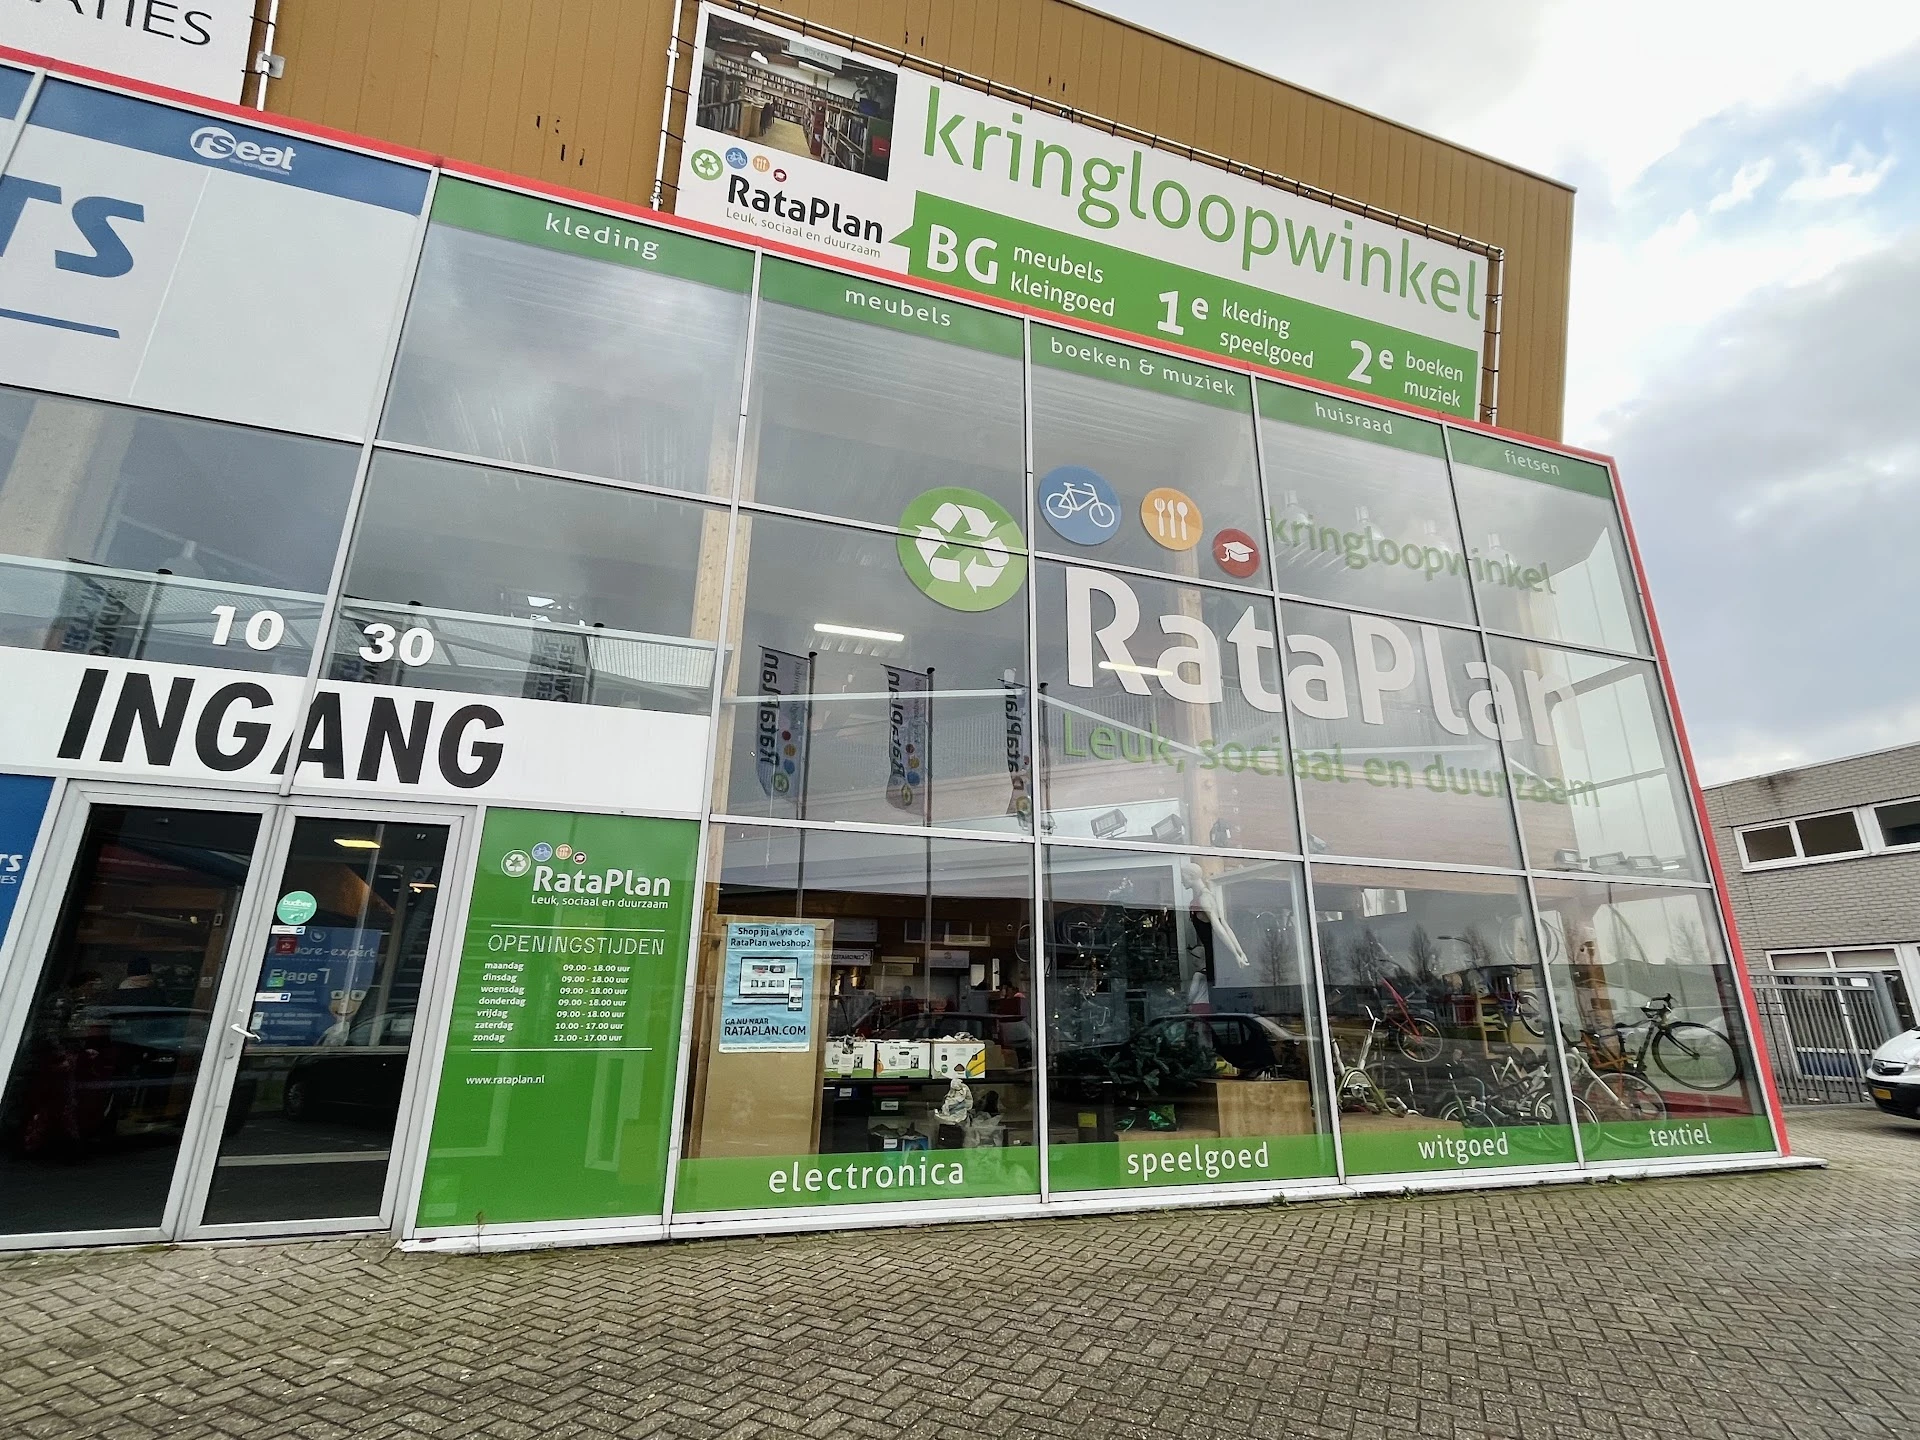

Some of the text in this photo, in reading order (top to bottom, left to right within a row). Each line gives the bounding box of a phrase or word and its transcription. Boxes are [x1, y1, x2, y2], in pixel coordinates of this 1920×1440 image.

[728, 174, 883, 244] RataPlan
[924, 86, 1480, 321] kringloopwinkel
[545, 212, 660, 260] kleding
[726, 208, 881, 258] Leuk, sociaal en duurzaam
[927, 224, 999, 285] BG
[1013, 246, 1104, 283] meubels
[845, 288, 951, 327] meubels
[1010, 271, 1115, 317] kleingoed
[1222, 298, 1291, 339] kleding
[1219, 330, 1314, 369] speelgoed
[1051, 337, 1236, 396] boeken & muziek
[1406, 350, 1464, 383] boeken
[1403, 379, 1461, 408] muziek
[1315, 402, 1393, 435] huisraad
[1503, 450, 1561, 476] fietsen
[1270, 506, 1557, 594] kringloopwinkel
[209, 604, 435, 668] 10 30
[1066, 567, 1587, 751] RataPlan
[57, 668, 505, 789] INGANG
[1063, 712, 1600, 808] Leuk, sociaal en duurzaam
[533, 865, 671, 897] RataPlan
[531, 894, 669, 909] Leuk, sociaal en duurzaam
[487, 933, 665, 956] OPENINGSTIJDEN
[730, 938, 811, 948] RataPlan webshop?
[738, 927, 758, 937] Shop
[760, 928, 769, 937] jij
[770, 928, 779, 936] al
[482, 973, 518, 983] dinsdag
[484, 962, 524, 972] maandag
[563, 964, 586, 972] 09.00
[593, 964, 616, 972] 18.00
[478, 997, 527, 1007] donderdag
[480, 985, 525, 995] woensdag
[560, 987, 583, 995] 09.00
[590, 987, 613, 995] 18.00
[474, 1021, 514, 1031] zaterdag
[476, 1009, 508, 1019] vrijdag
[724, 1025, 806, 1036] RATAPLAN.COM
[472, 1033, 505, 1043] zondag
[553, 1034, 578, 1042] 12.00
[584, 1034, 607, 1042] 17.00
[466, 1075, 545, 1086] www.rataplan.nl
[1418, 1131, 1509, 1164] witgoed
[1648, 1122, 1713, 1148] textiel
[768, 1156, 964, 1193] electronica
[1127, 1141, 1269, 1181] speelgoed
